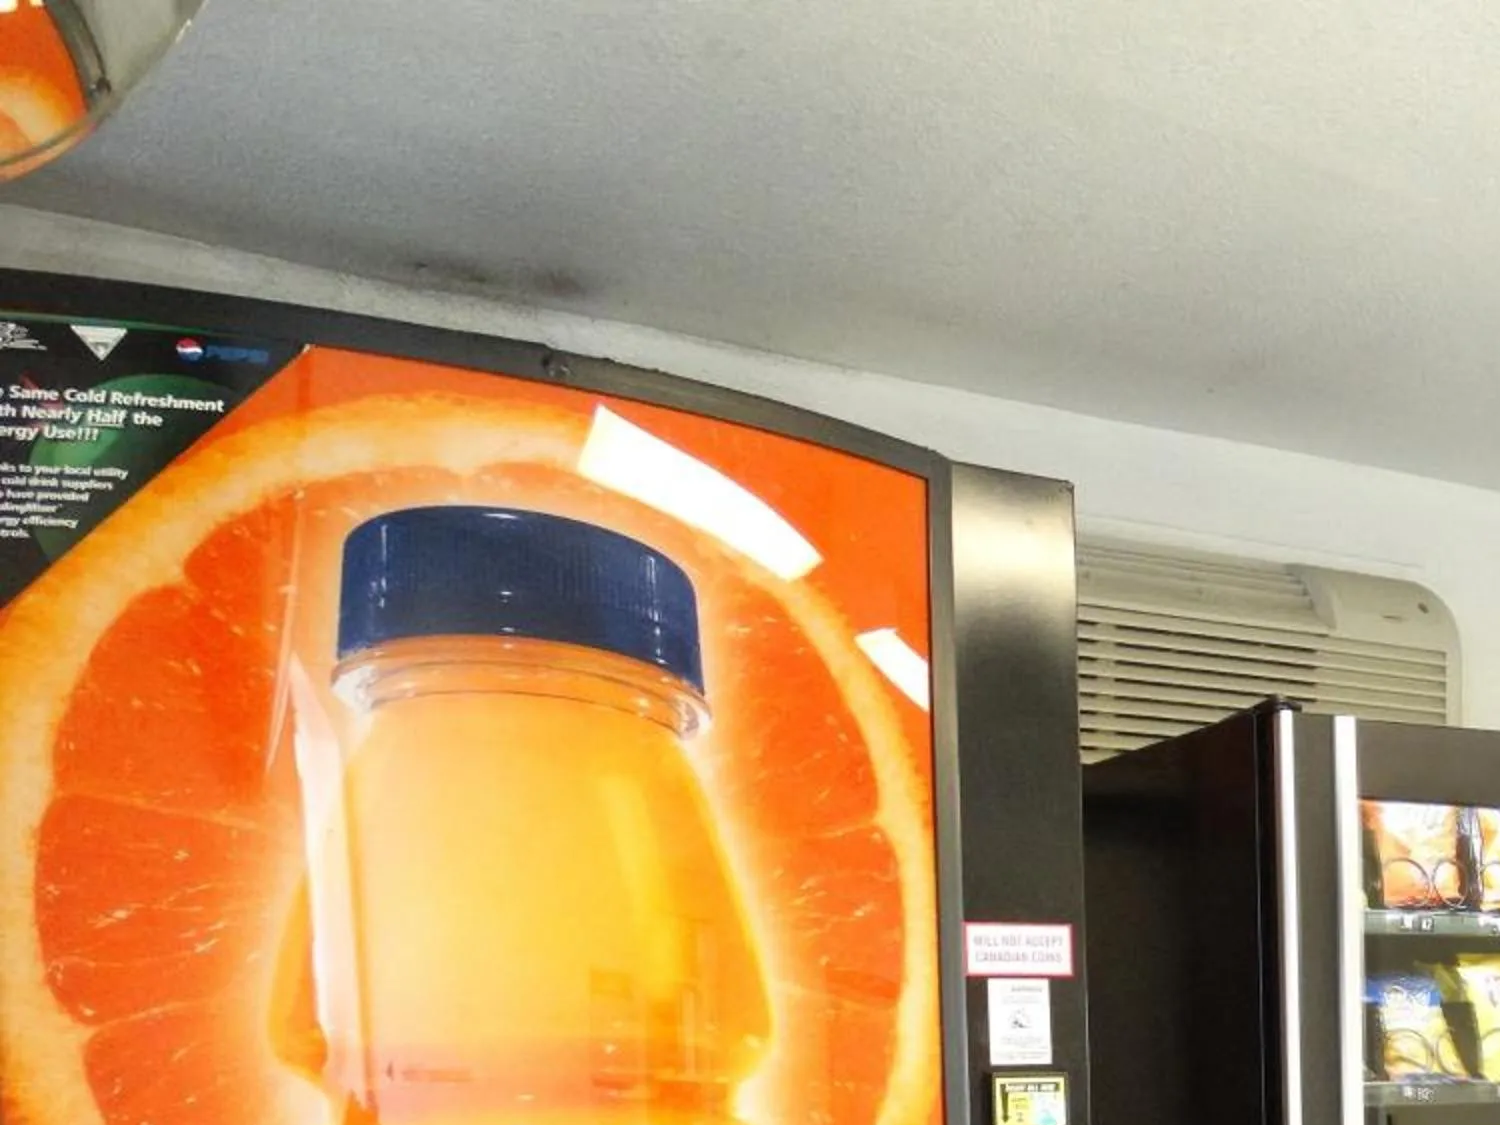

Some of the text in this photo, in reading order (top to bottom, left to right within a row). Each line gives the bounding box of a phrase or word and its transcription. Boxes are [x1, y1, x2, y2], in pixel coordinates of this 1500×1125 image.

[9, 385, 224, 412] Same Cold Refreshment
[21, 405, 83, 424] Nearly
[88, 408, 127, 426] Half
[132, 412, 164, 427] the
